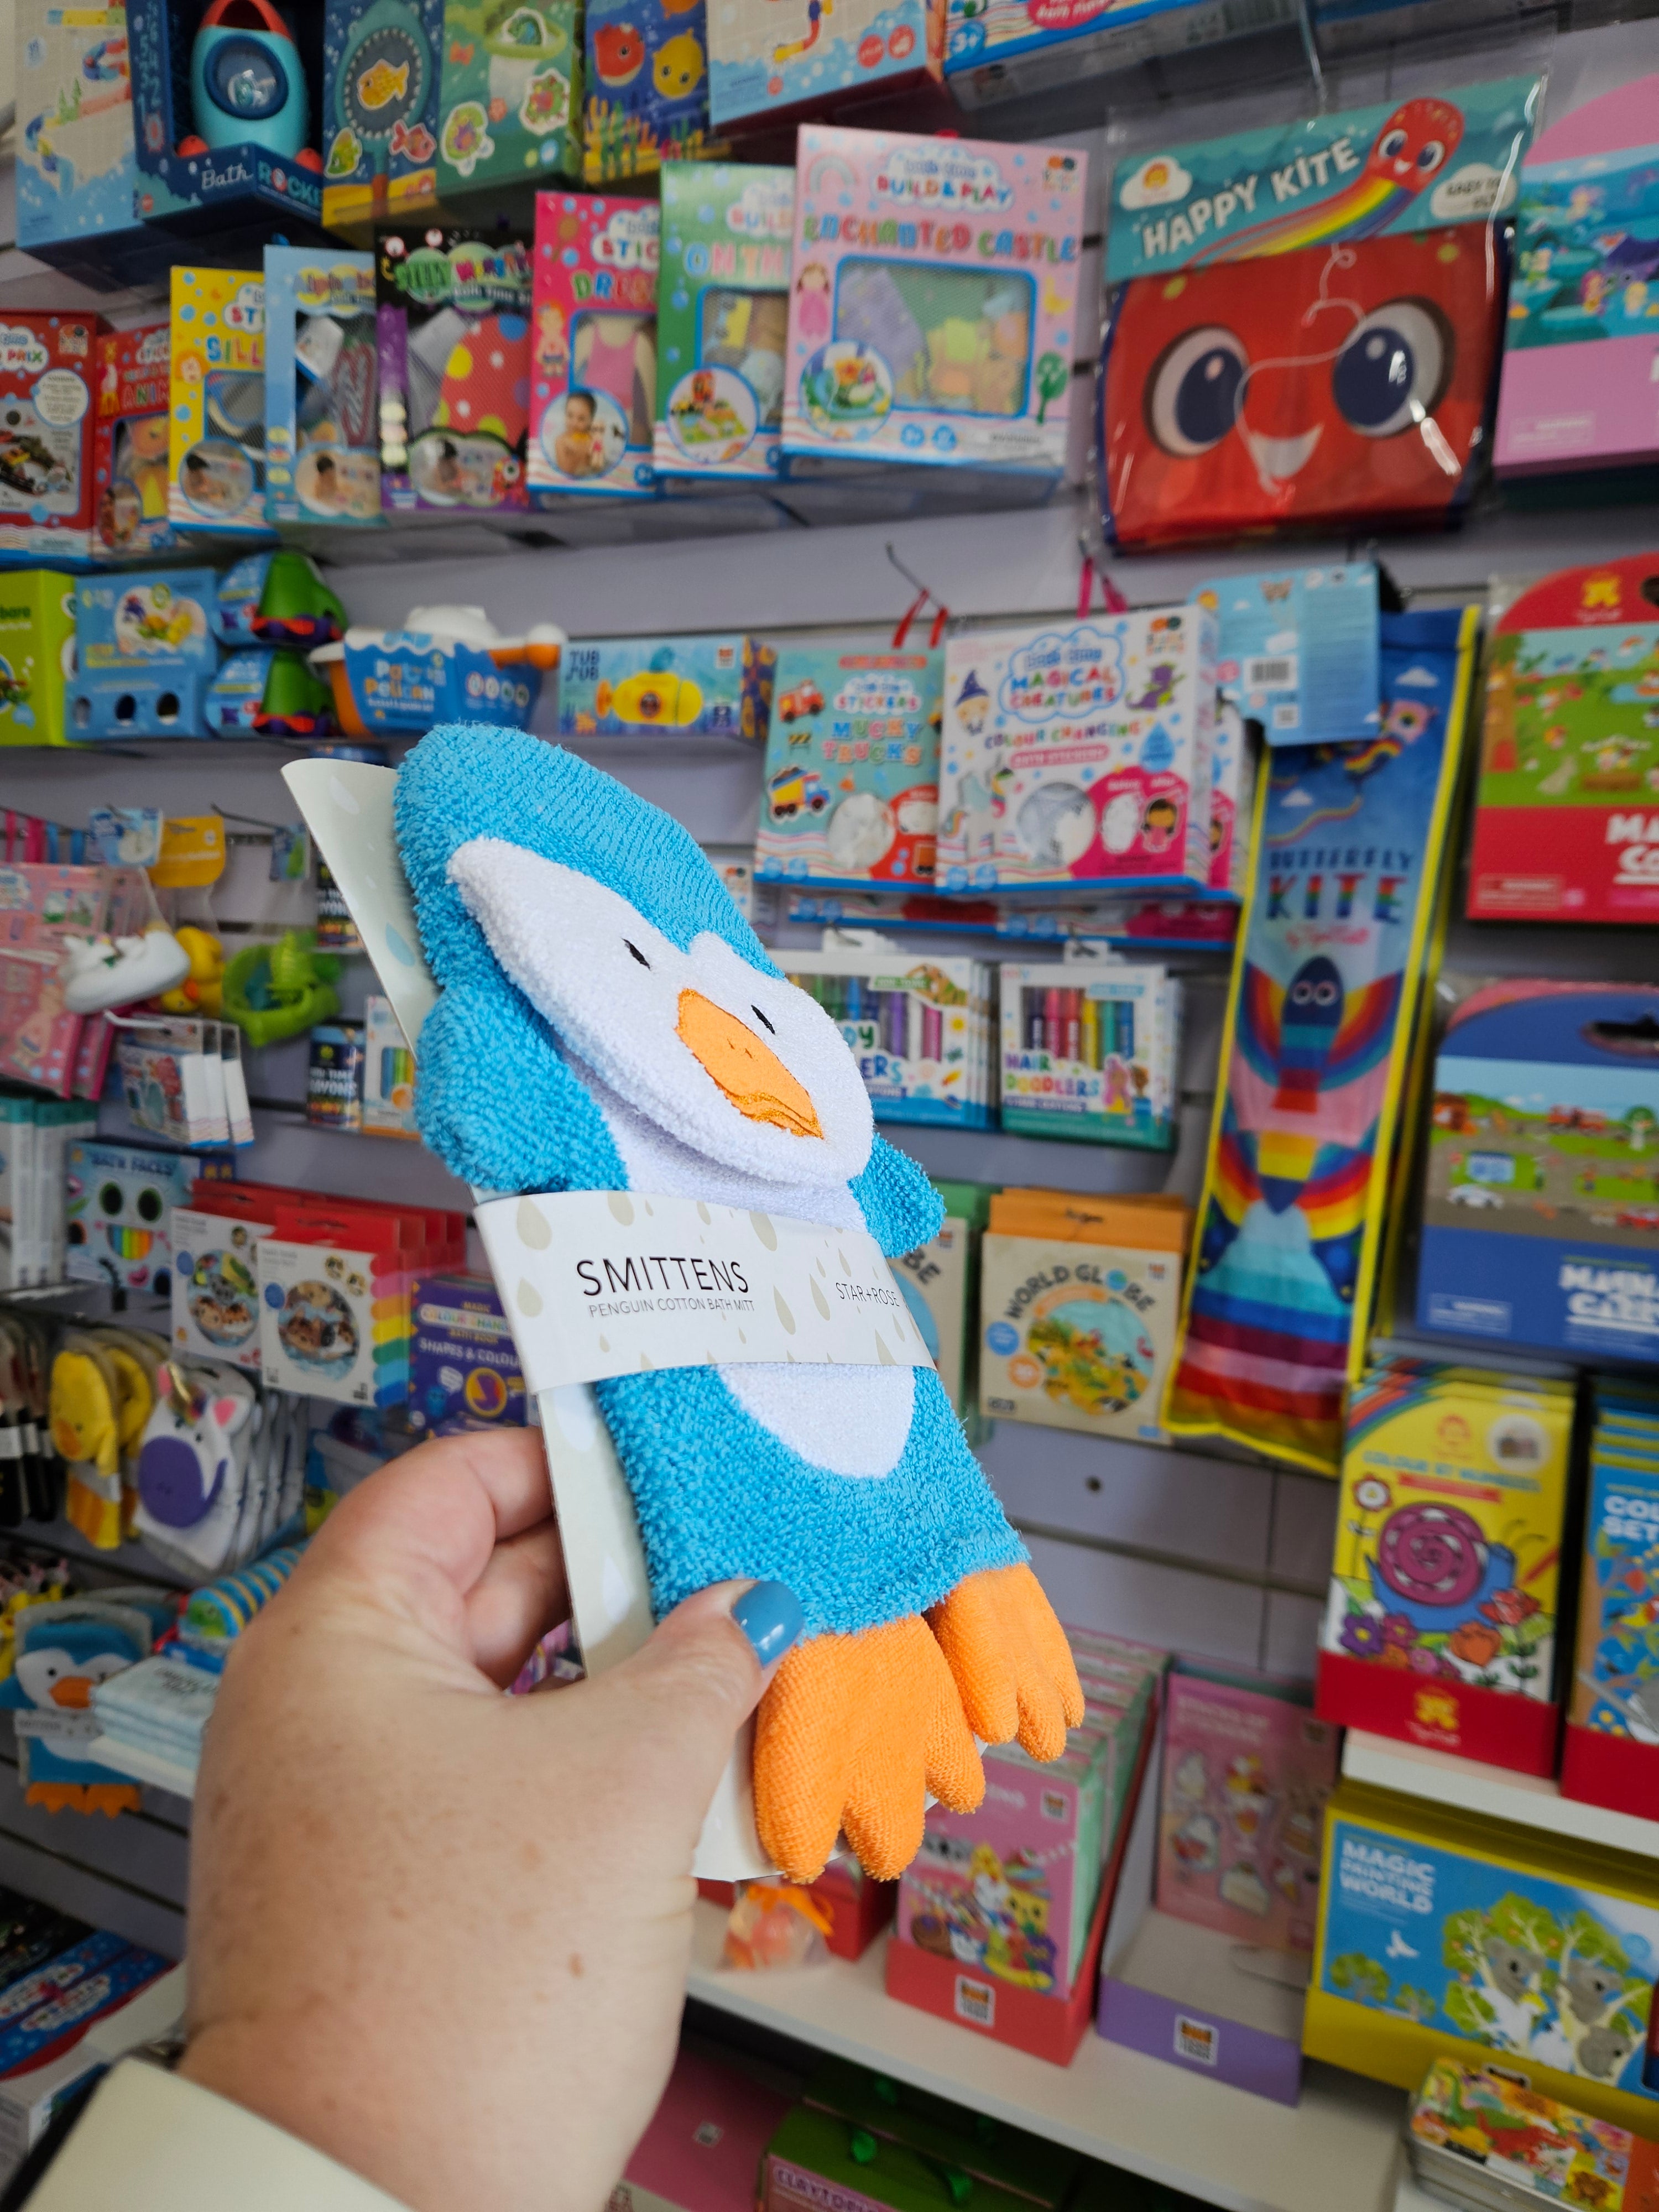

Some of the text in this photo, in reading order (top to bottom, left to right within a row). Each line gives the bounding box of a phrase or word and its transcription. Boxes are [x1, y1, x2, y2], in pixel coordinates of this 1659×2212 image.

[201, 164, 253, 189] Bath
[1142, 137, 1360, 259] HAPPY KITE
[978, 228, 1075, 262] CASTLE
[207, 335, 262, 366] SILL
[1011, 667, 1116, 690] MAGICAL
[1011, 687, 1115, 708] CREATURES
[823, 740, 921, 765] TRUCKS
[1266, 874, 1406, 922] KITE
[1005, 1053, 1051, 1071] HAIR
[1005, 1073, 1100, 1098] DOODLERS
[577, 1256, 749, 1296] SMITTENS
[836, 1282, 900, 1307] STAR+ROSE
[1005, 1265, 1070, 1320] WORLD
[589, 1297, 755, 1318] PENGUIN COTTON BATH MITT
[419, 1338, 463, 1359] SHAPES
